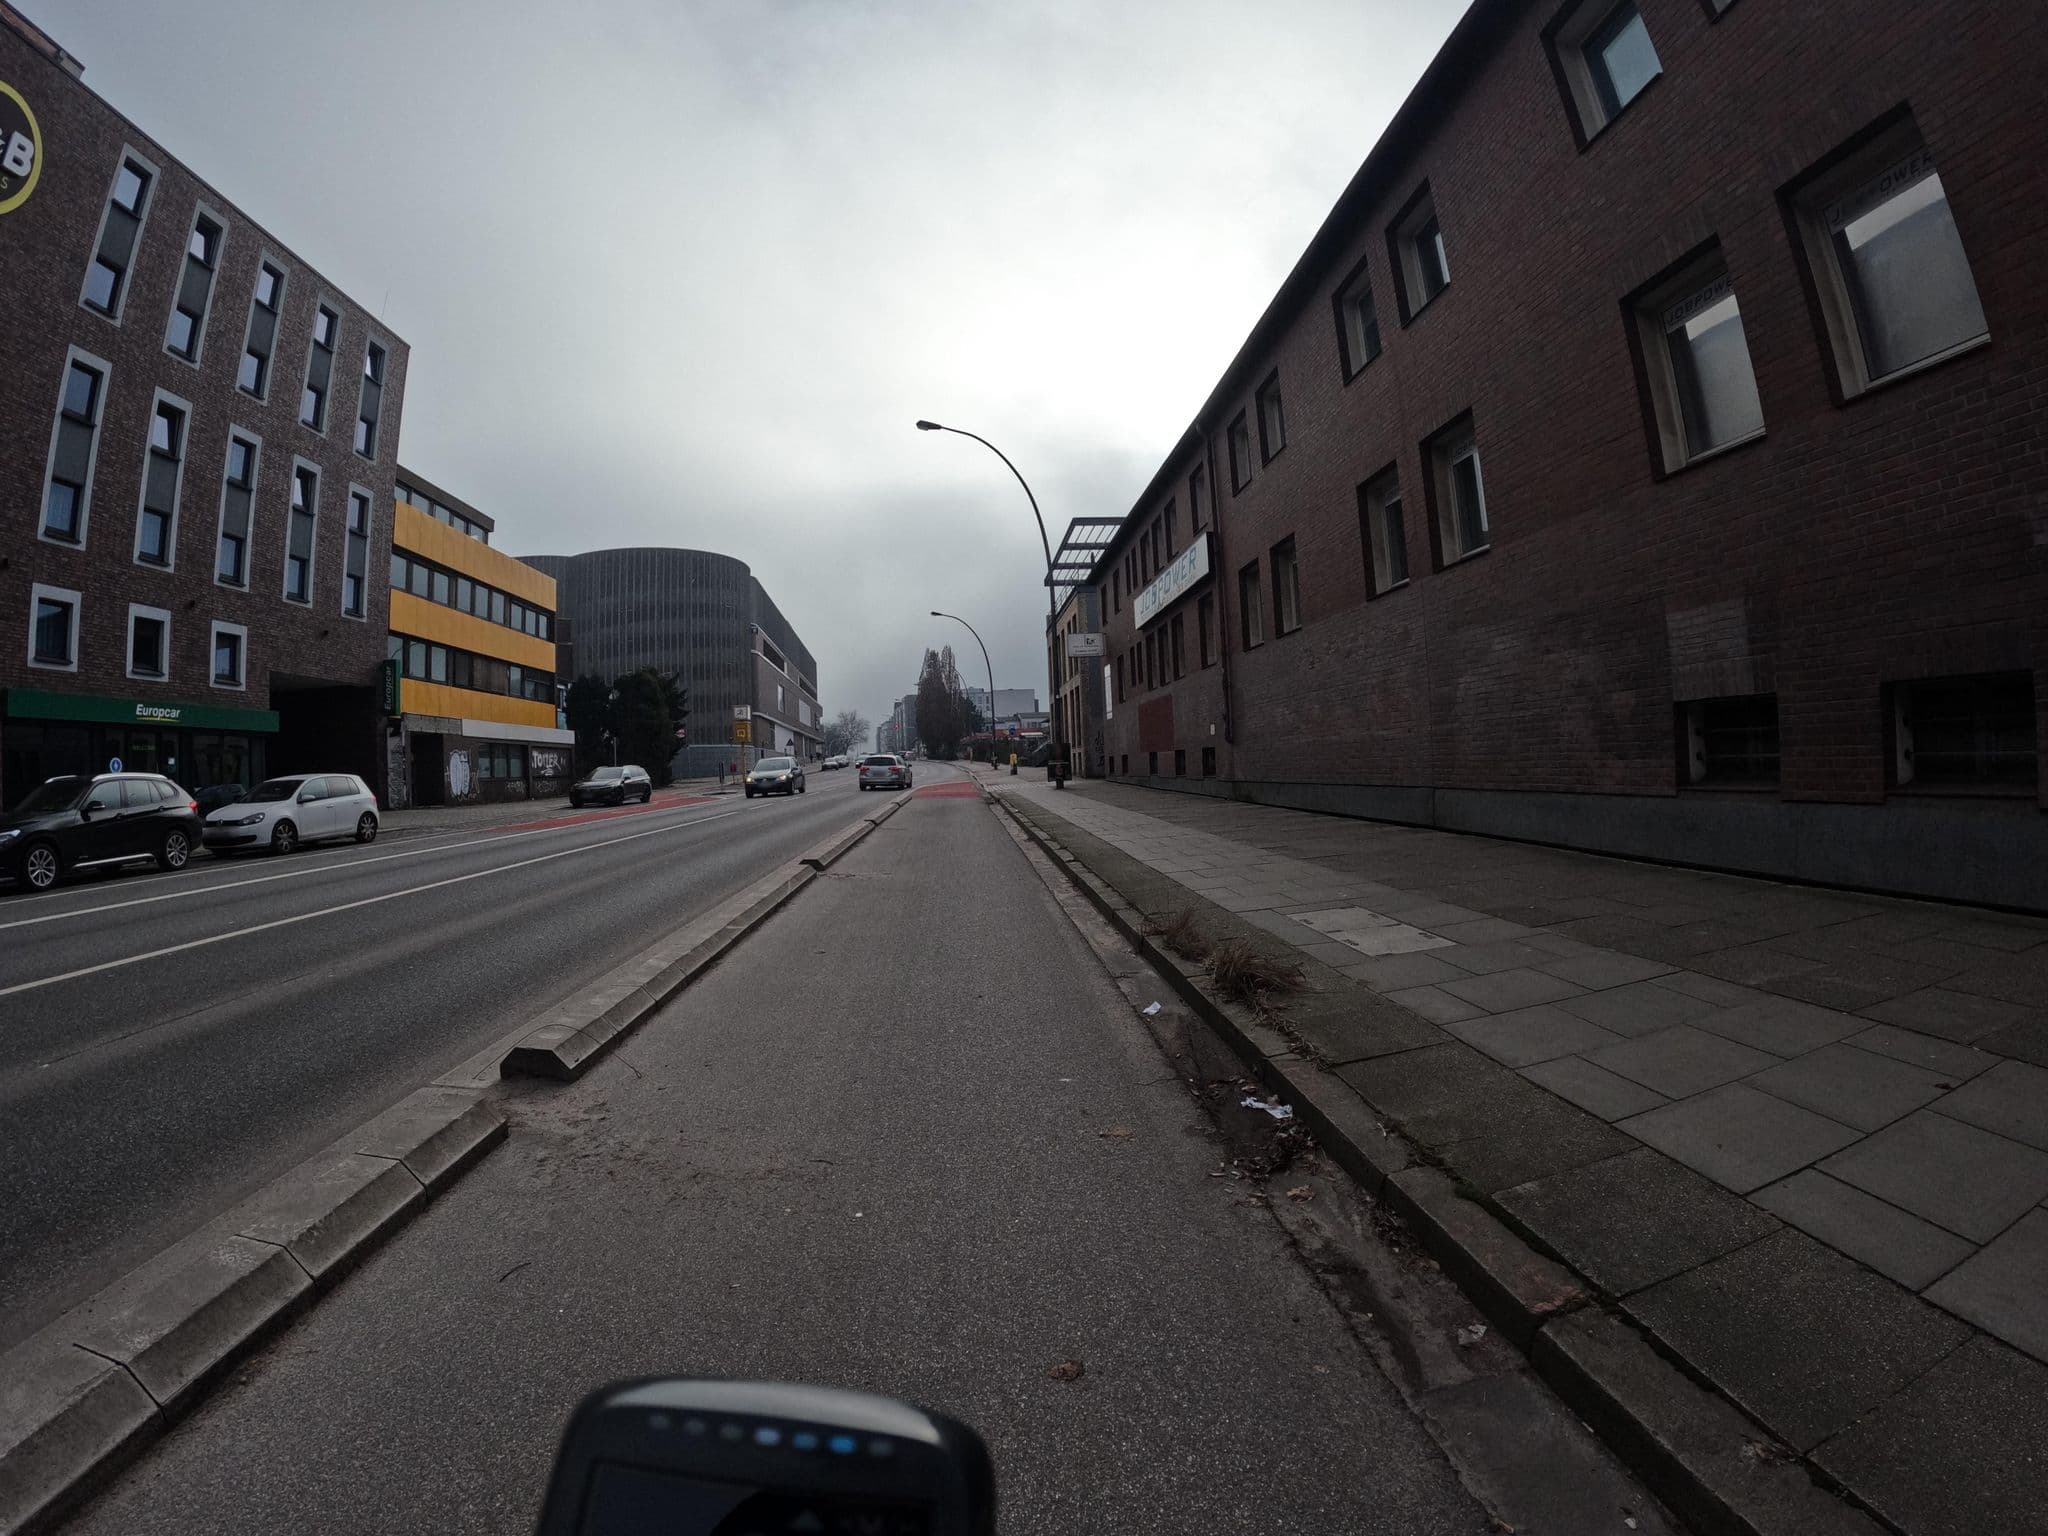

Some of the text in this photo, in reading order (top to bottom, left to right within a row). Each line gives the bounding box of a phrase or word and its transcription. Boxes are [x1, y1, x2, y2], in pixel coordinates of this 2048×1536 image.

[0, 128, 35, 177] B
[384, 665, 393, 711] Europcar
[136, 703, 181, 721] Europcar
